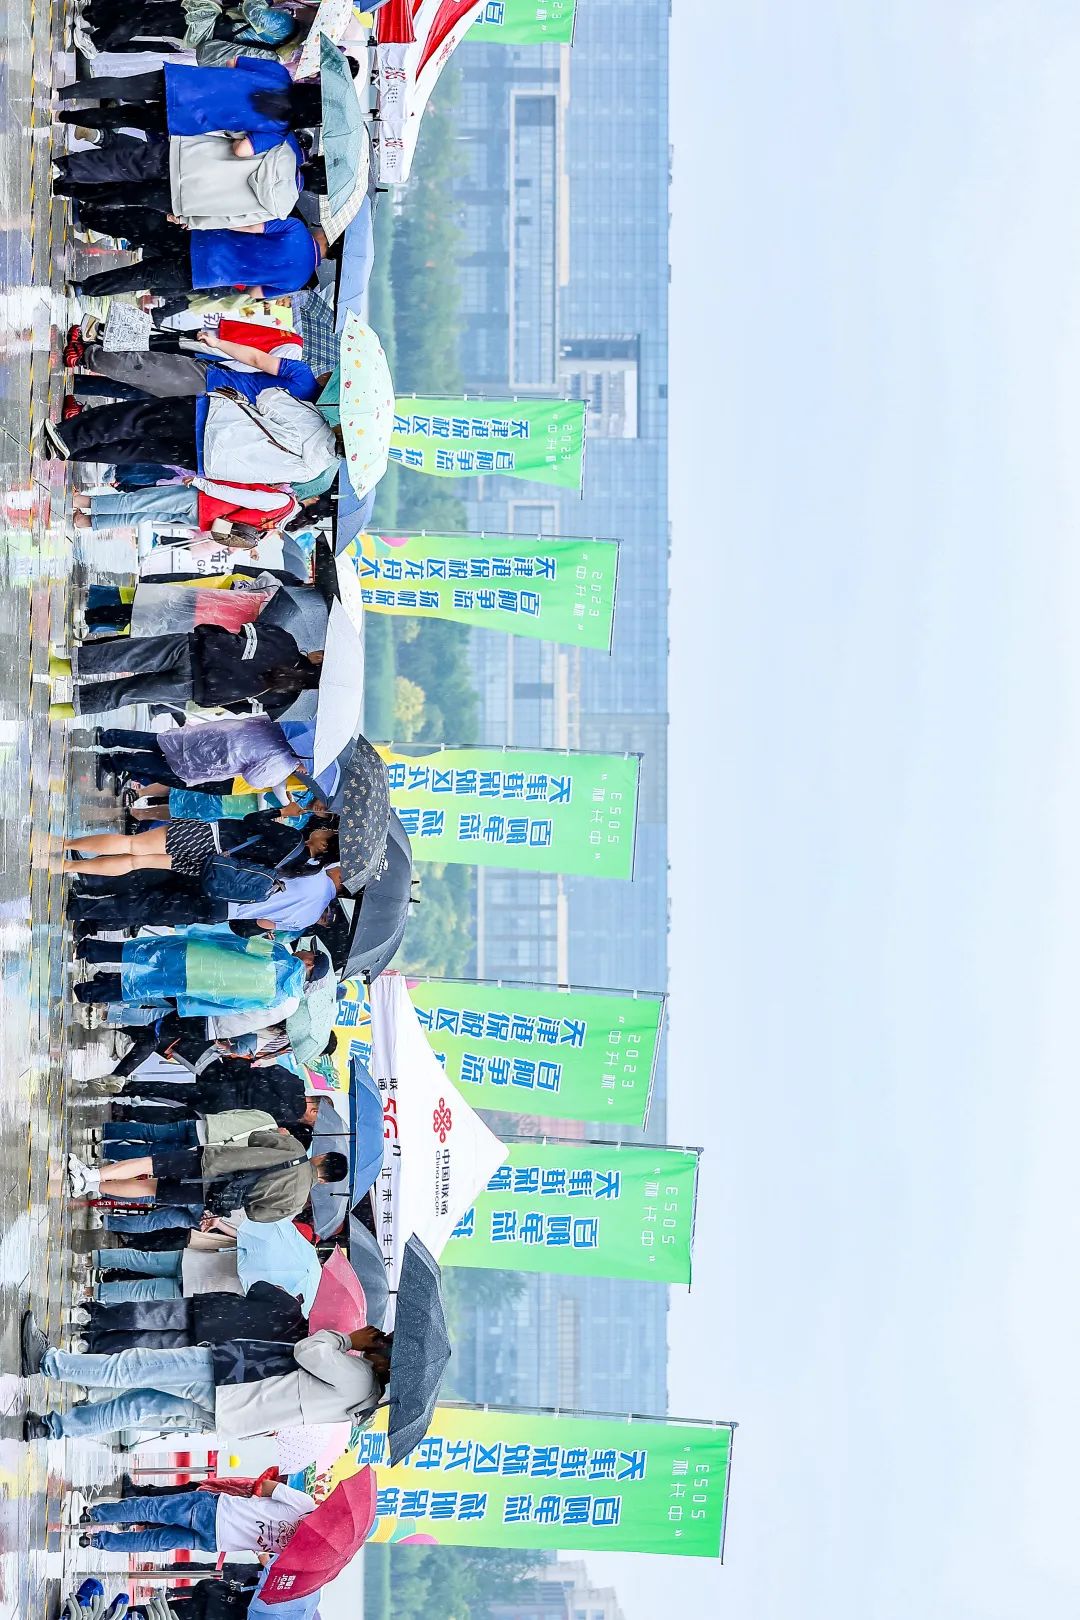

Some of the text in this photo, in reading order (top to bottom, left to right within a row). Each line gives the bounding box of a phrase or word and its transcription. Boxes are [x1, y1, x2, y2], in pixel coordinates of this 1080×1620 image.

[392, 415, 529, 438] 天津港保税区龙
[560, 424, 572, 461] 2023
[588, 570, 602, 617] 2023
[622, 1034, 640, 1088] 2023
[440, 1148, 450, 1216] 中国联通
[382, 1166, 394, 1268] 让未来生长
